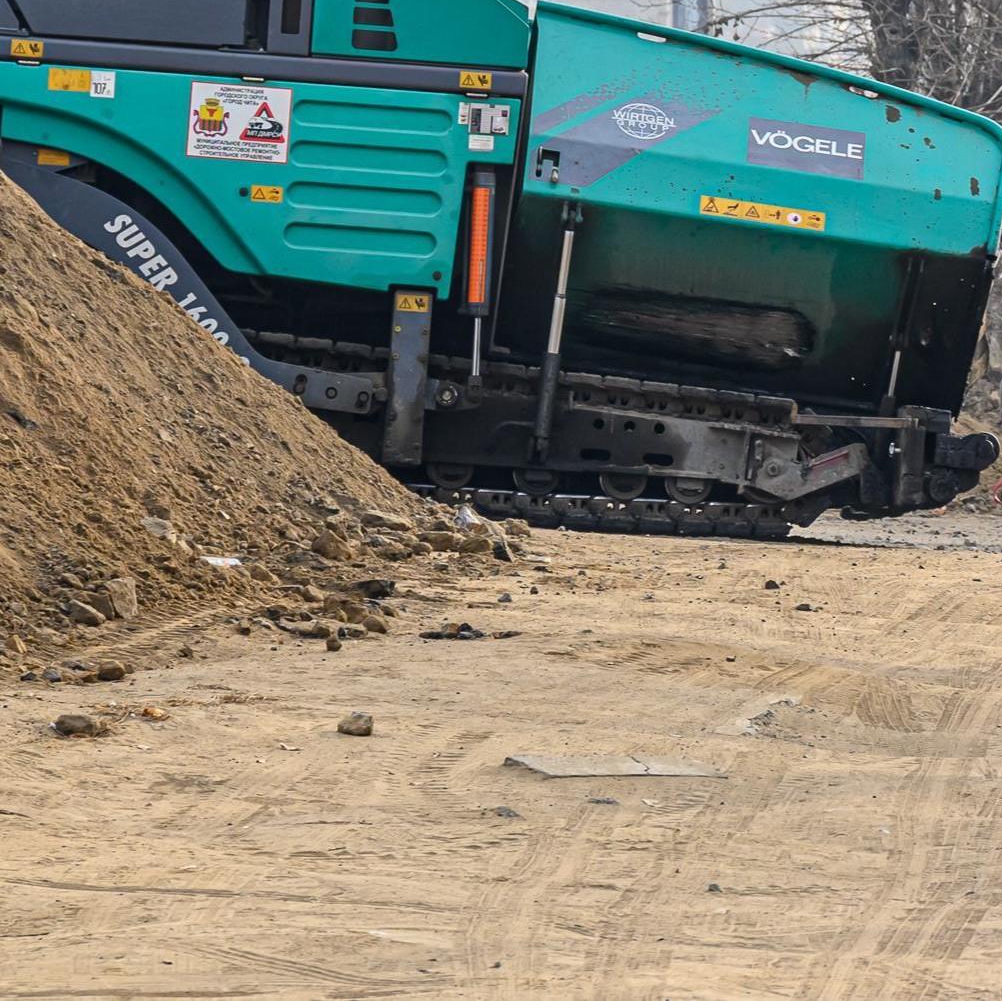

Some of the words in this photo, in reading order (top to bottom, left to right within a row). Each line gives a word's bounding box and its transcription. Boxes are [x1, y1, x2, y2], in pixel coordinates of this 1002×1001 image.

[613, 109, 675, 125] WIRTGEN
[616, 119, 670, 131] GROUP
[751, 128, 864, 160] VÖGELE
[103, 214, 178, 292] SUPER
